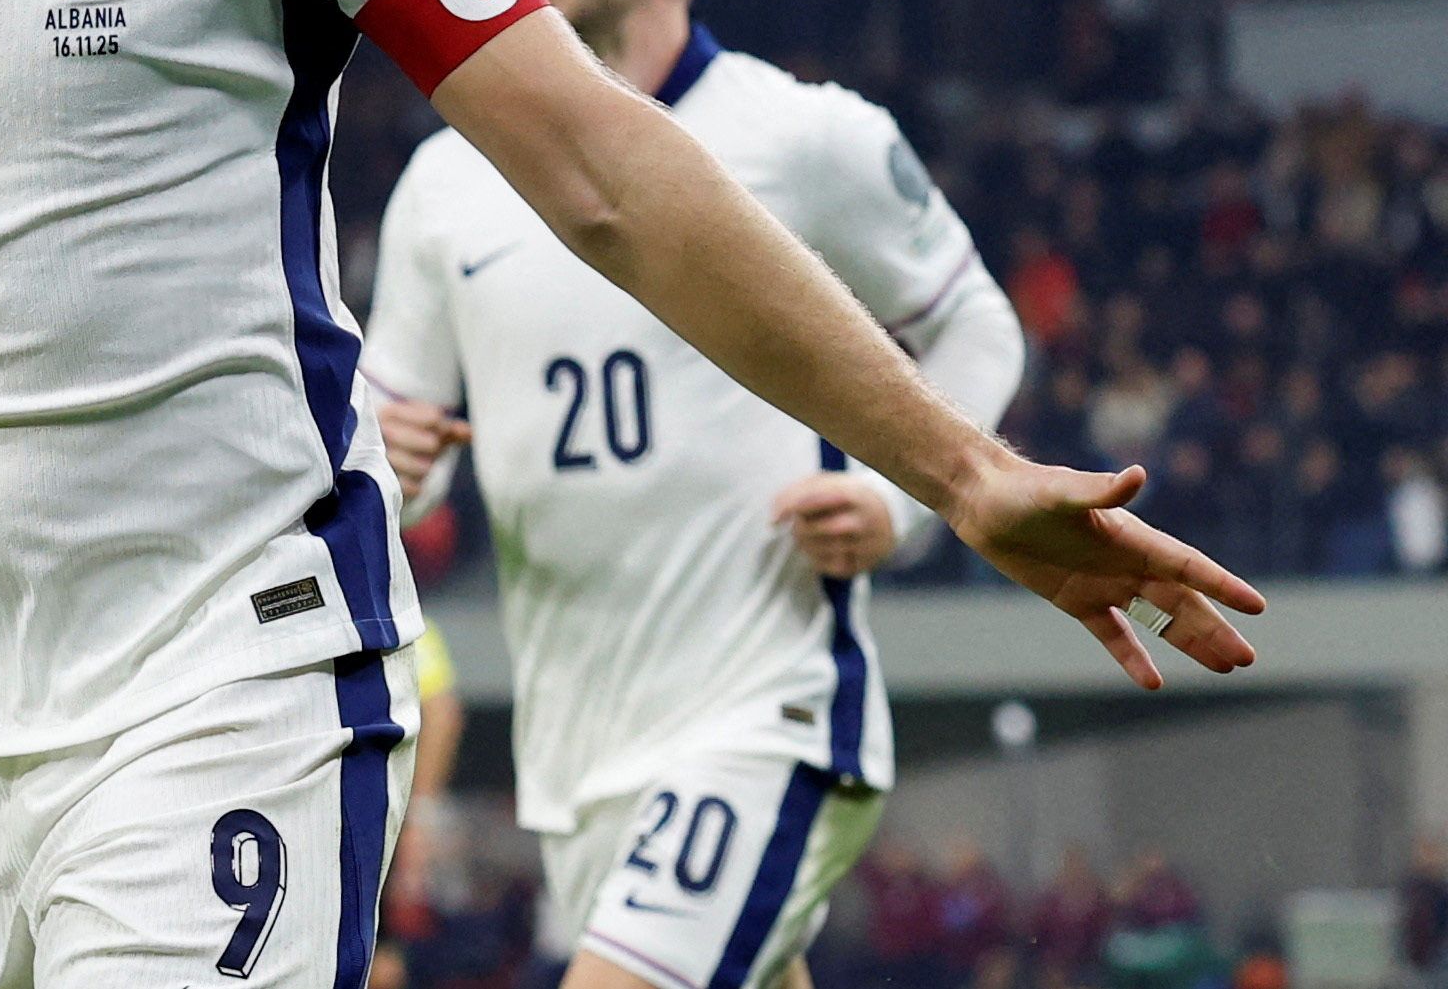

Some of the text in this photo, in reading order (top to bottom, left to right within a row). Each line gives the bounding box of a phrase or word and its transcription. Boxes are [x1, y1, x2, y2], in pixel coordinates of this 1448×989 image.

[45, 7, 127, 30] ALBANIA
[53, 34, 119, 57] 16.11.25
[545, 349, 652, 469] 20
[624, 790, 739, 893] 20
[210, 808, 288, 979] 9
